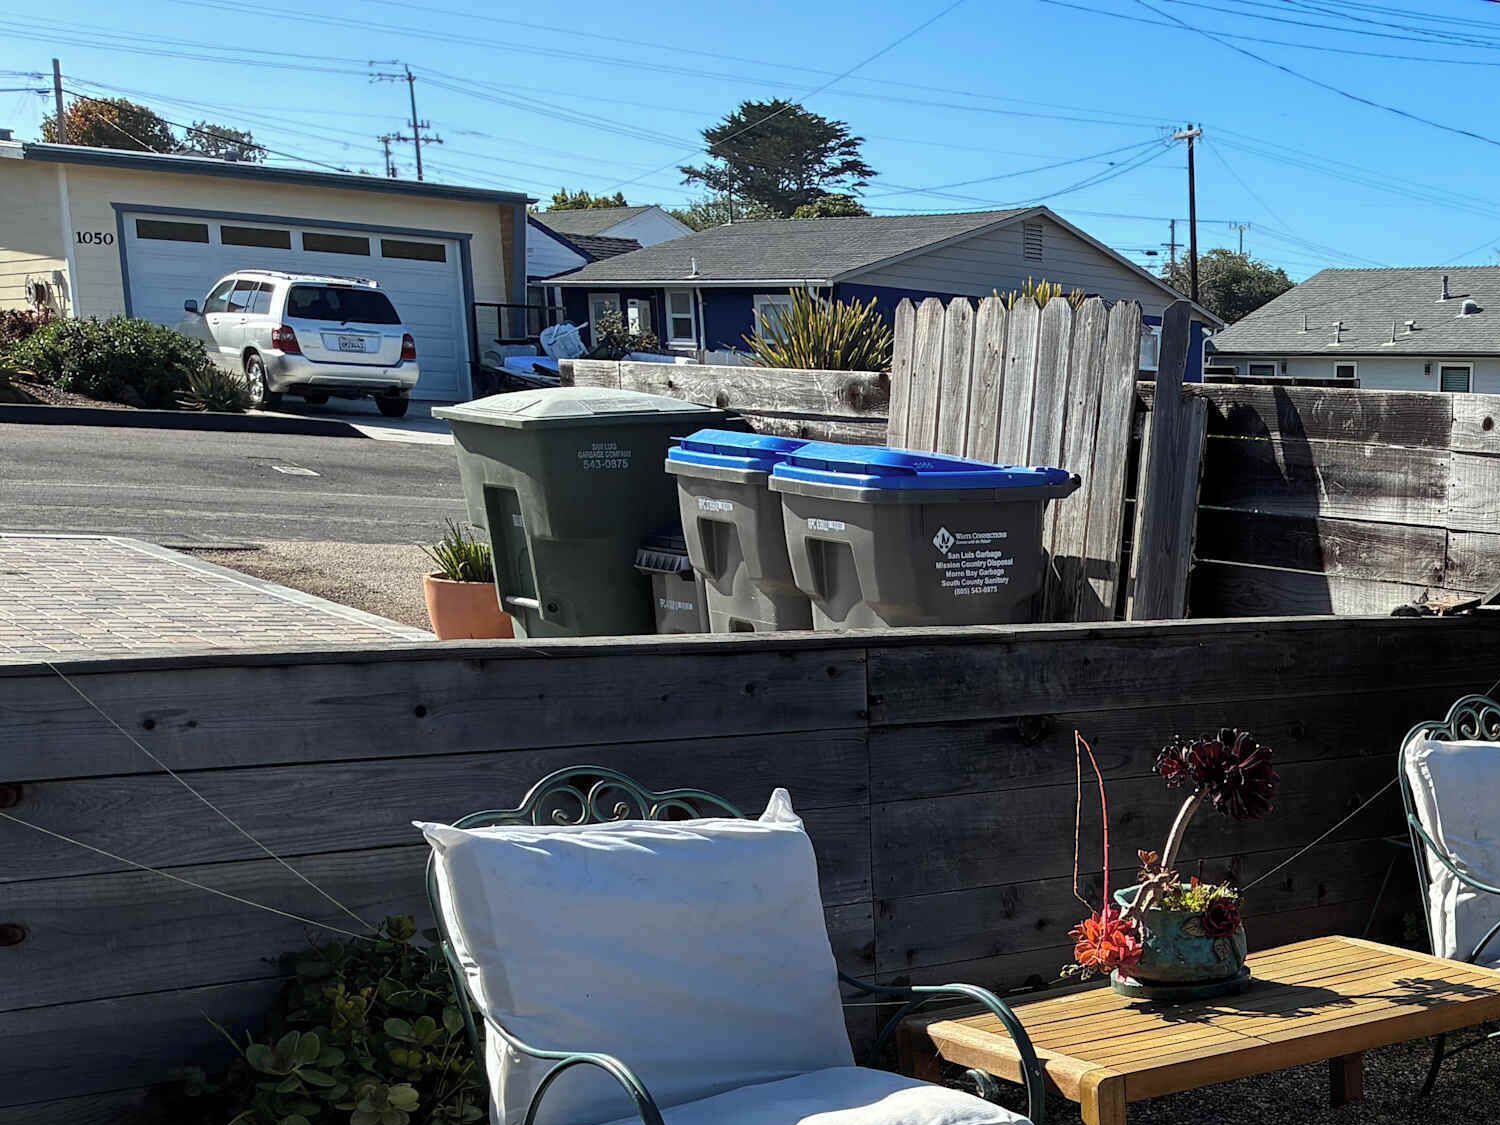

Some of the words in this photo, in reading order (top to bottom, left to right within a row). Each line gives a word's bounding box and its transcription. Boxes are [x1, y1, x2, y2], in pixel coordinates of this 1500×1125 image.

[76, 231, 114, 246] 1050
[947, 552, 960, 560] San
[961, 551, 975, 559] Luis
[975, 550, 1002, 559] Garbage
[935, 561, 960, 569] Mission
[961, 560, 987, 569] Country
[987, 558, 1014, 567] Disposal
[945, 570, 965, 578] Morro
[965, 570, 978, 578] Bay
[978, 568, 1005, 576] Garbage
